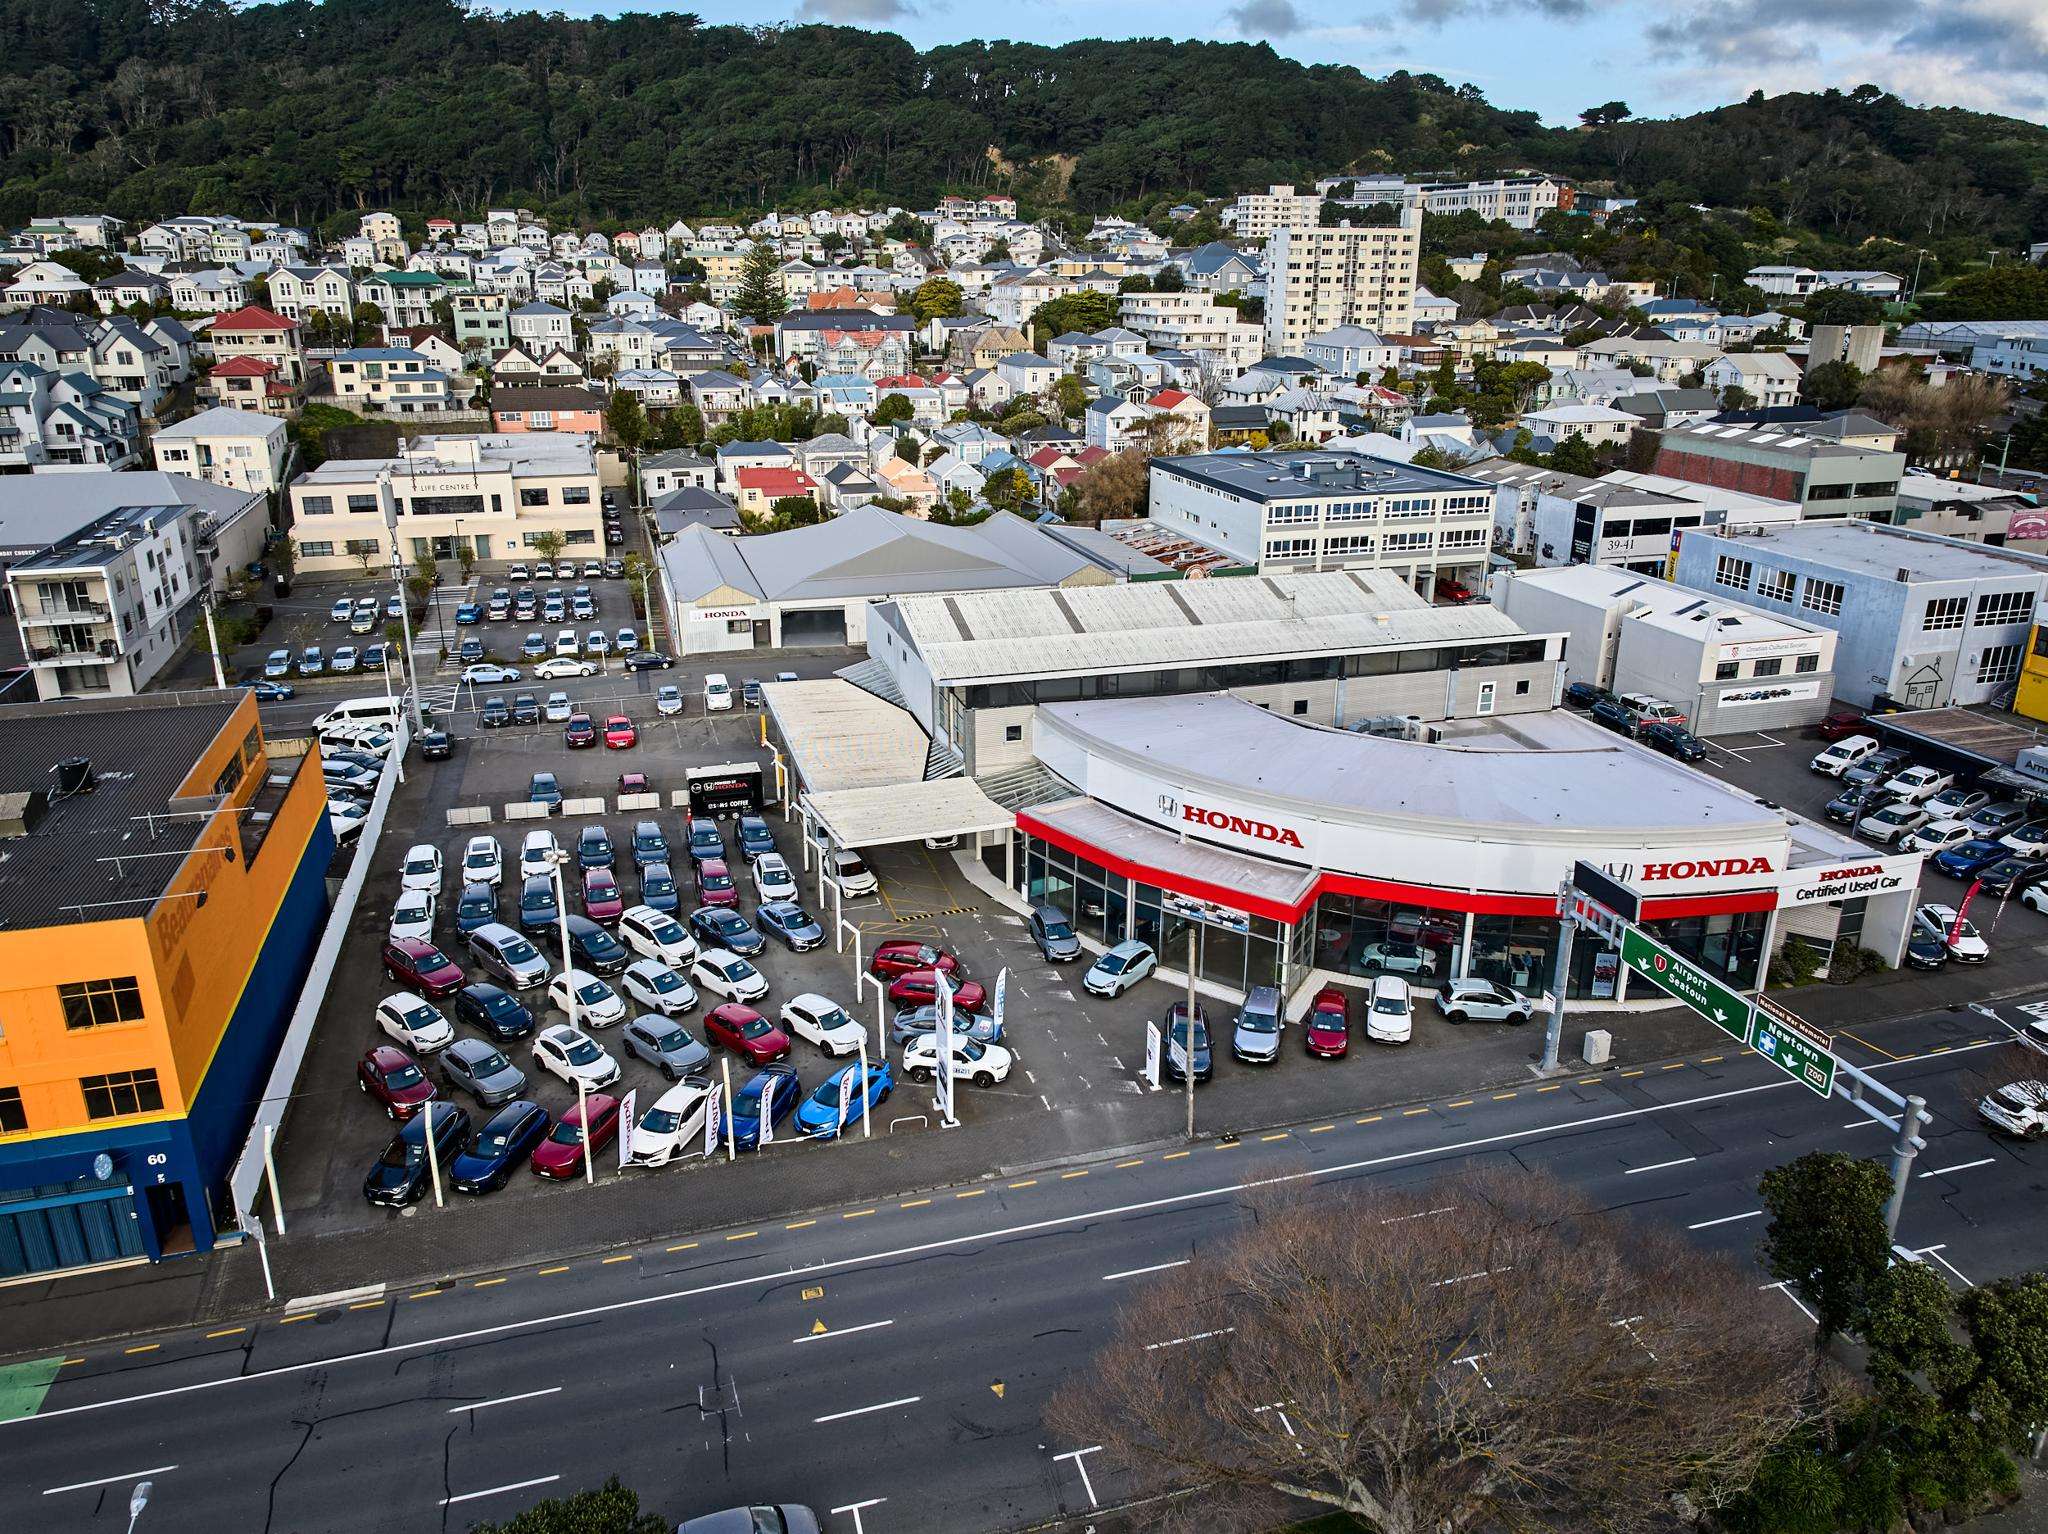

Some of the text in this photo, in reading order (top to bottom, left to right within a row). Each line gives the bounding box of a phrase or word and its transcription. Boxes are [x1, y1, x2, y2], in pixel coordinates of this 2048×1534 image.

[440, 483, 470, 491] CENTRE
[1607, 539, 1634, 551] 39-41
[1668, 556, 1676, 578] Hertz
[704, 610, 747, 619] HONDA
[714, 782, 748, 790] HONDA
[1182, 804, 1304, 849] HONDA
[1640, 857, 1774, 881] HONDA
[1818, 864, 1884, 882] HONDA
[1796, 877, 1902, 900] Certified Used Car
[1672, 962, 1707, 990] Airport
[1668, 973, 1707, 1005] Seatoun
[1760, 998, 1829, 1046] National War Memorial
[1768, 1022, 1819, 1062] Newtown
[147, 1153, 167, 1166] 60
